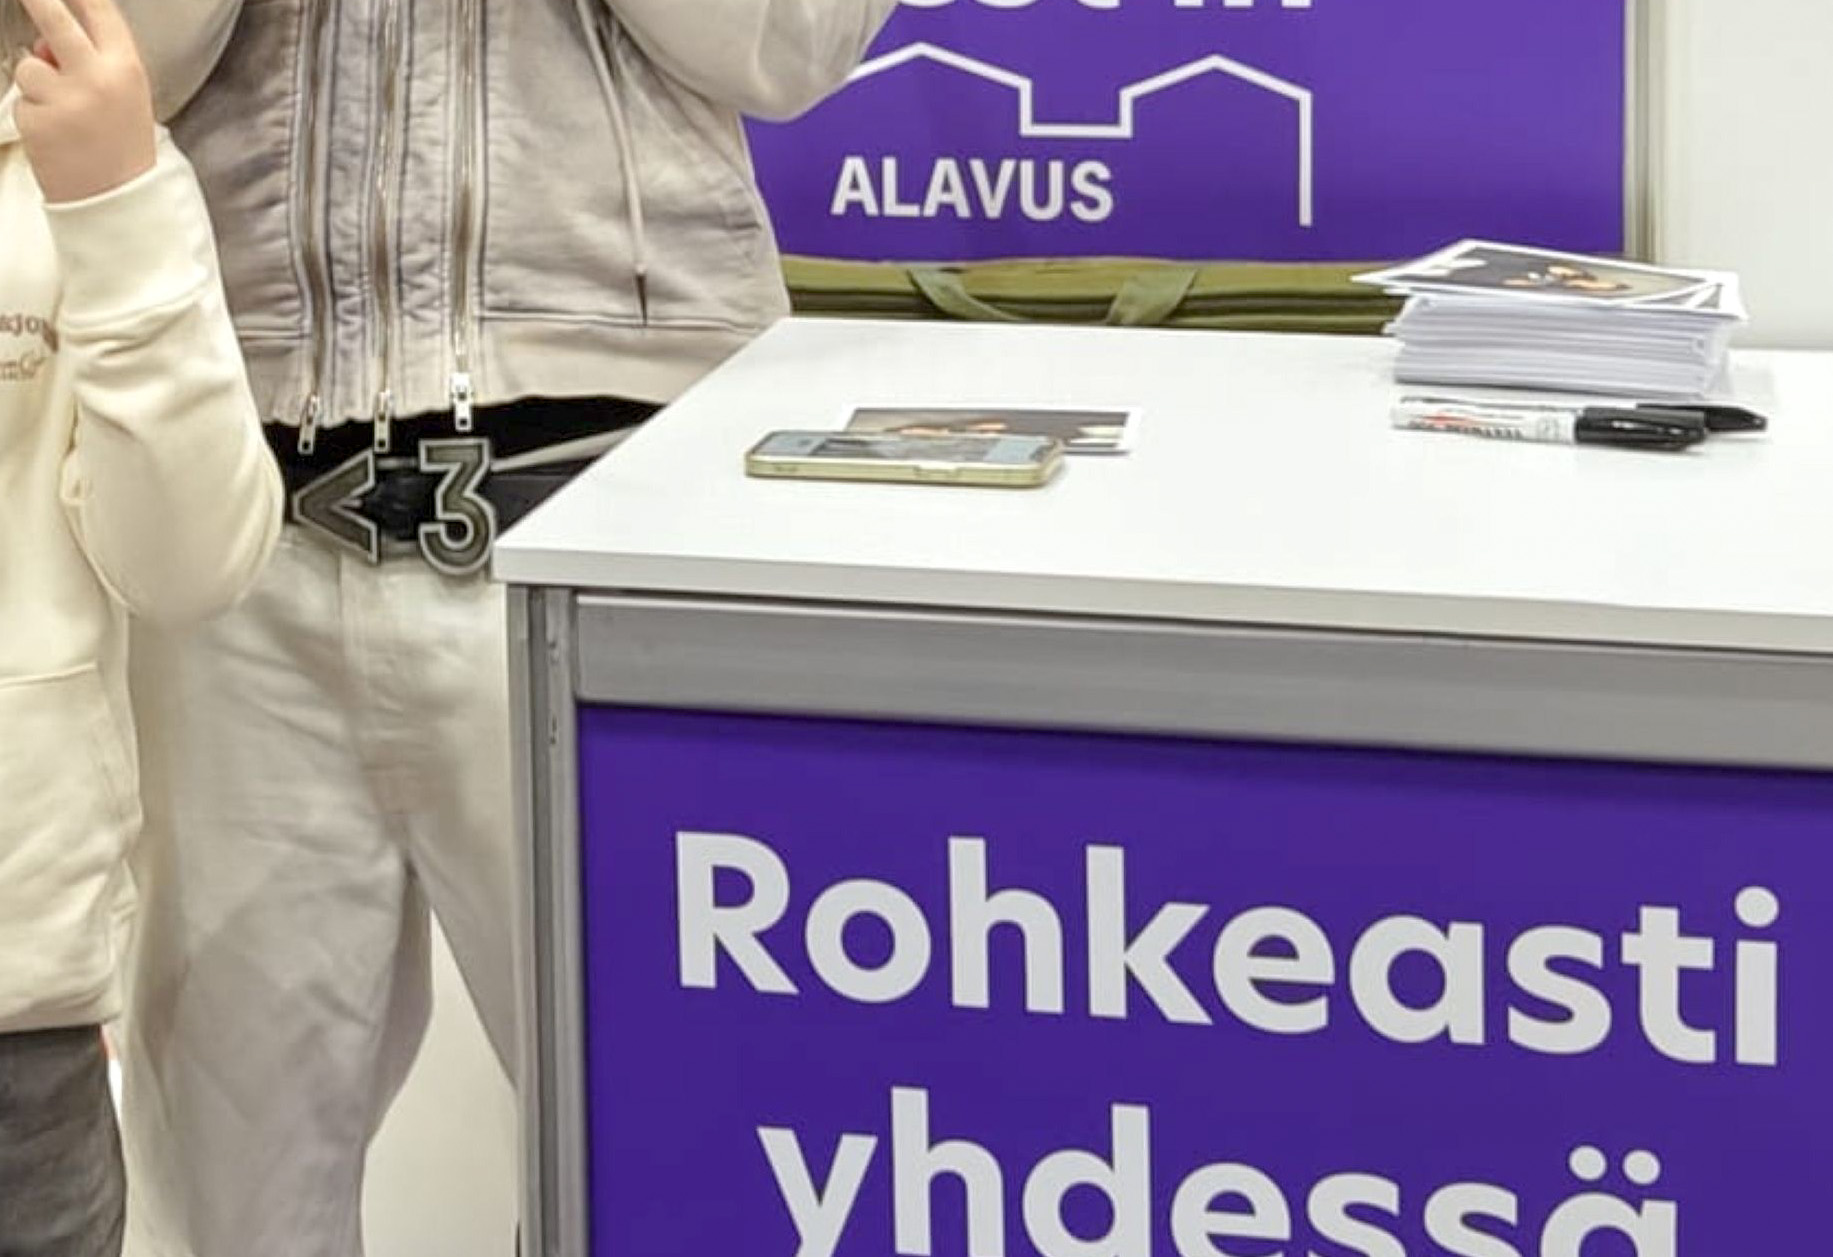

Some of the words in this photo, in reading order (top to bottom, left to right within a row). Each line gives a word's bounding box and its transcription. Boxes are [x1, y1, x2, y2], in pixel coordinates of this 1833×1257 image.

[832, 157, 1113, 221] ALAVUS
[676, 831, 1779, 1066] Rohkeasti
[757, 1087, 1677, 1257] yhdessä
